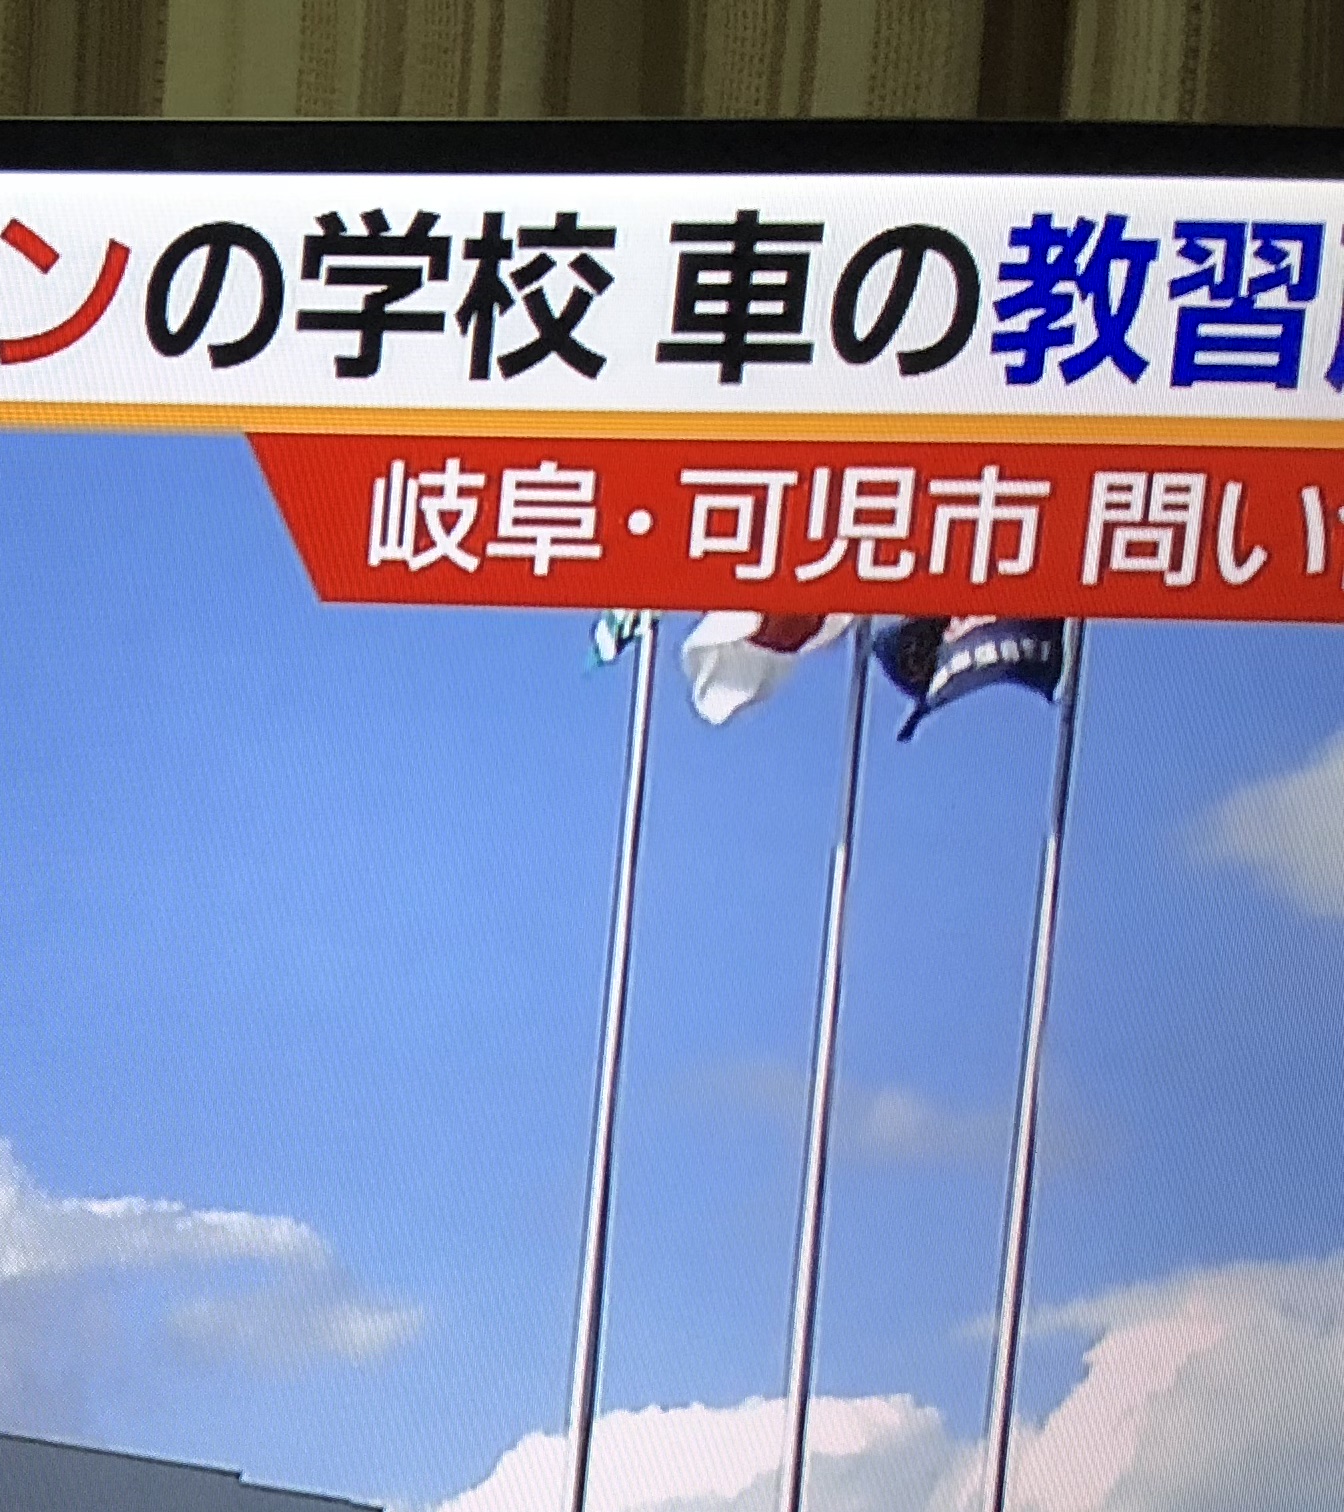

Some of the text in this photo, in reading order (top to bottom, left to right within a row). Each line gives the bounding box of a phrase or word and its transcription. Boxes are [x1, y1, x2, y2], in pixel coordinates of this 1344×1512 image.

[654, 207, 1344, 393] 車の教習
[367, 458, 1344, 588] 岐阜・可児市 問い
